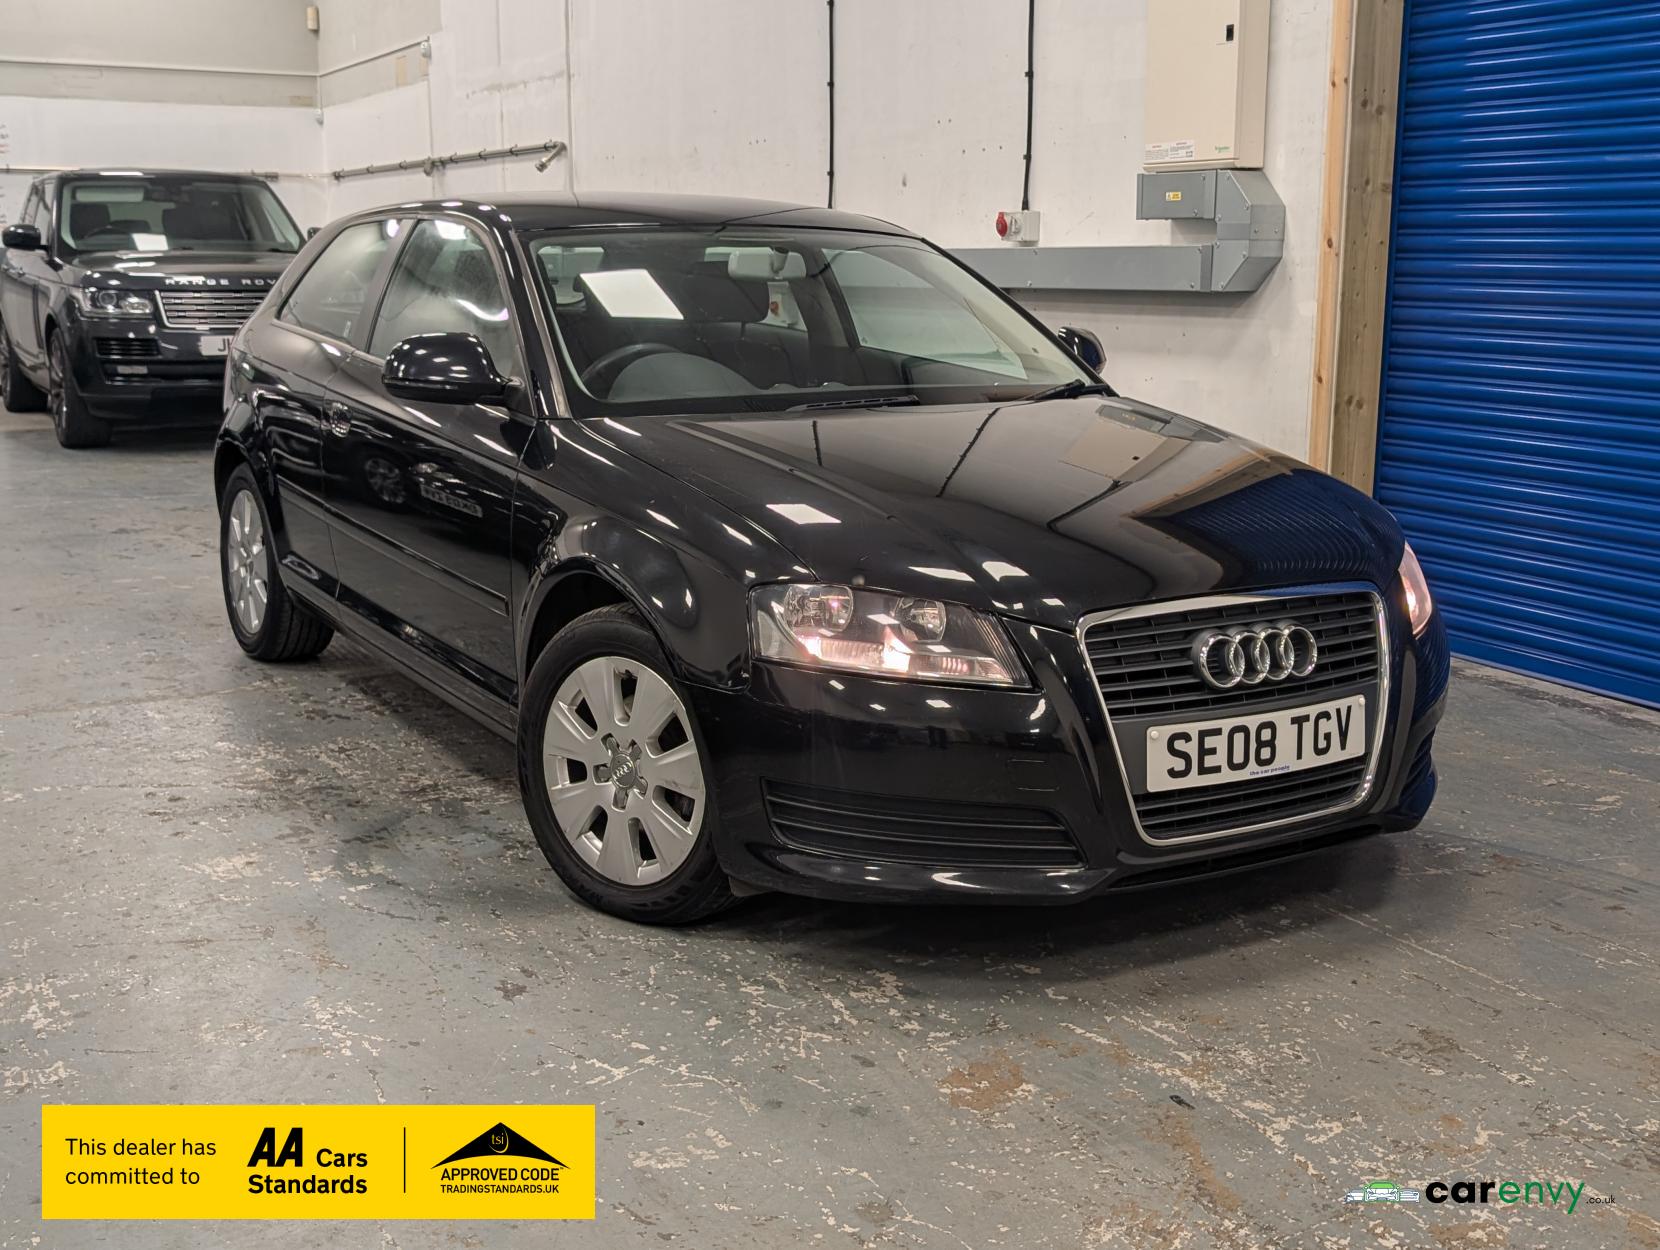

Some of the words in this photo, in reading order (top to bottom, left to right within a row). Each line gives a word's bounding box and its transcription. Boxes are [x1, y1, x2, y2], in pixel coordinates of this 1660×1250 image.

[165, 278, 230, 286] RANGE
[1166, 720, 1277, 779] SE08
[1290, 704, 1353, 761] TGV
